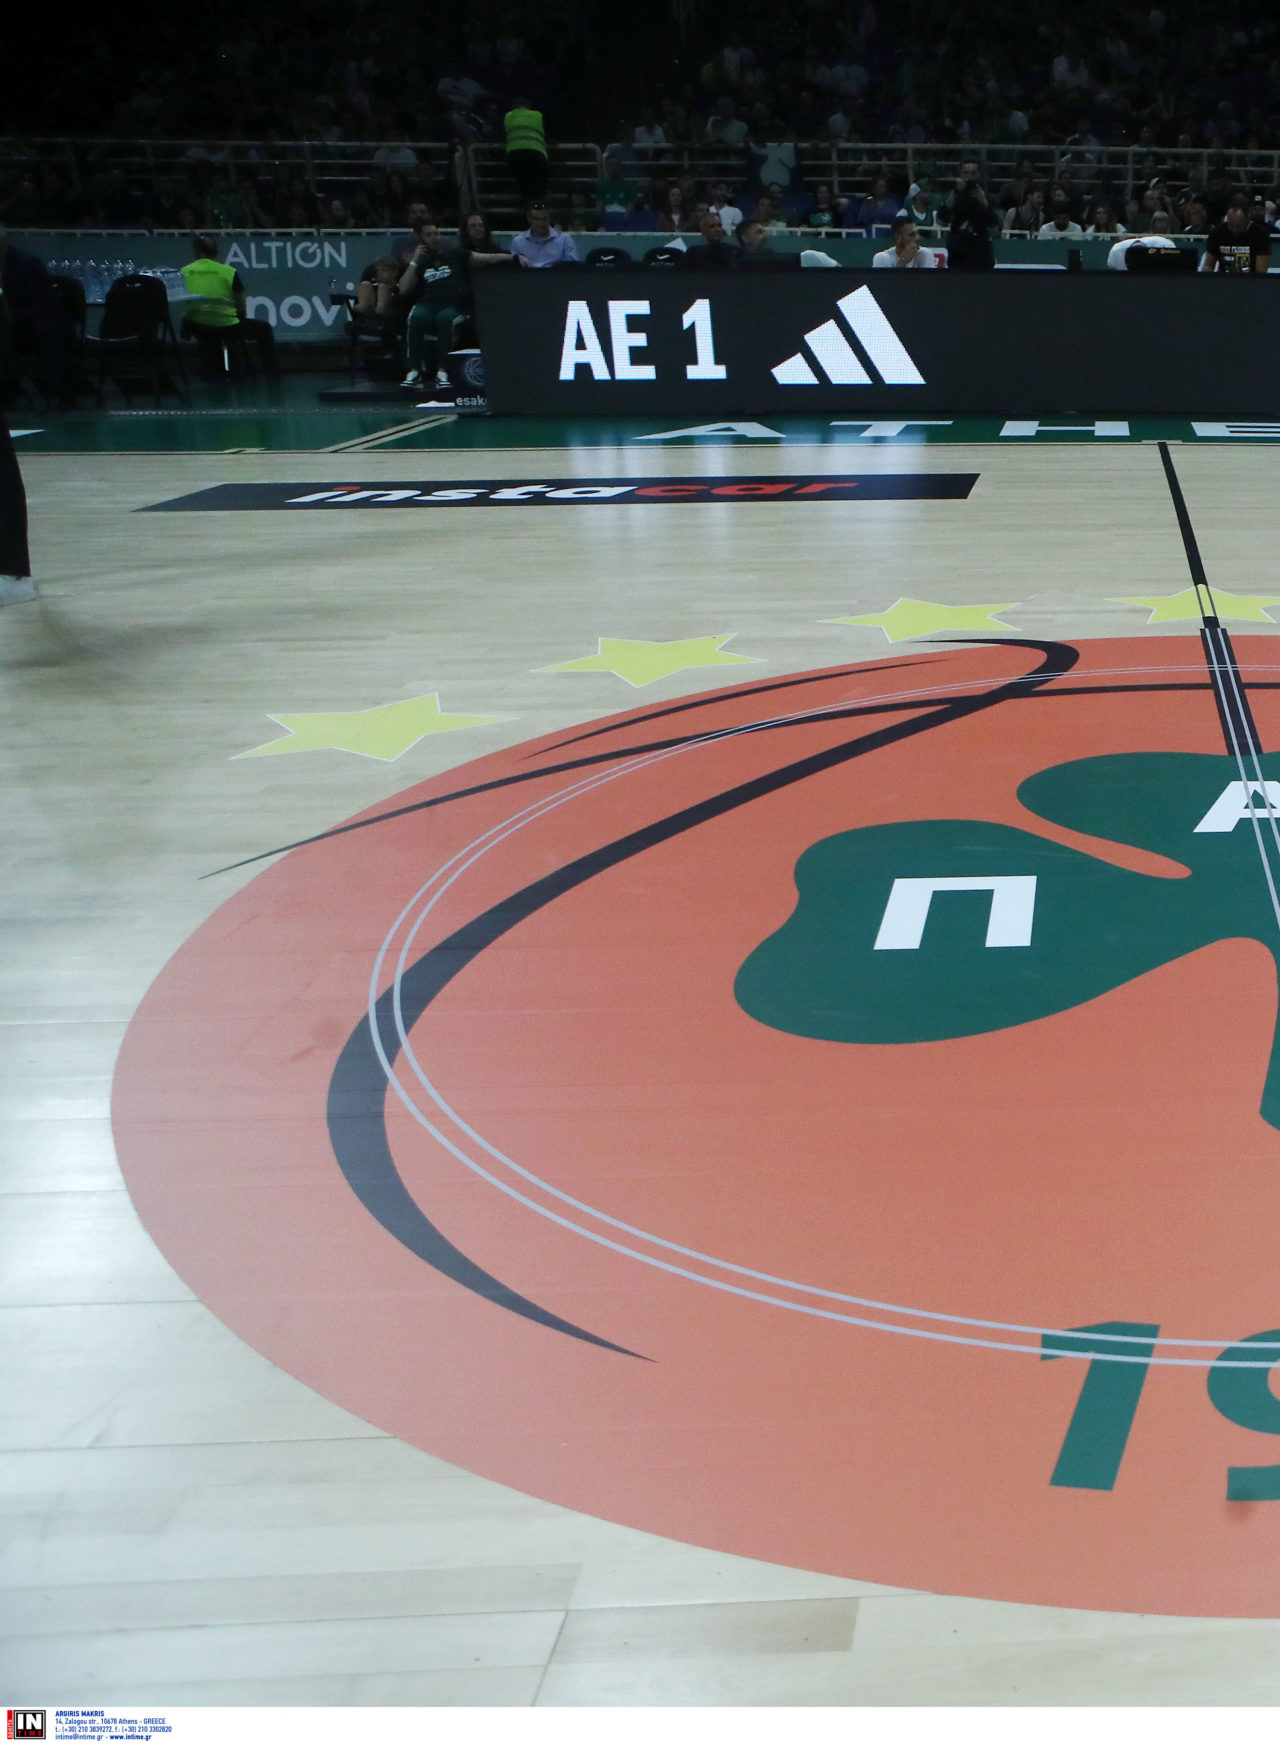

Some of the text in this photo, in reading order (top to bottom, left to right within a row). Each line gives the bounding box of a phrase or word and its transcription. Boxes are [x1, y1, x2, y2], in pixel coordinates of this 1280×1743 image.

[224, 241, 347, 268] ALTION
[559, 298, 727, 381] AE 1
[456, 394, 488, 406] esak
[283, 483, 860, 504] instacar
